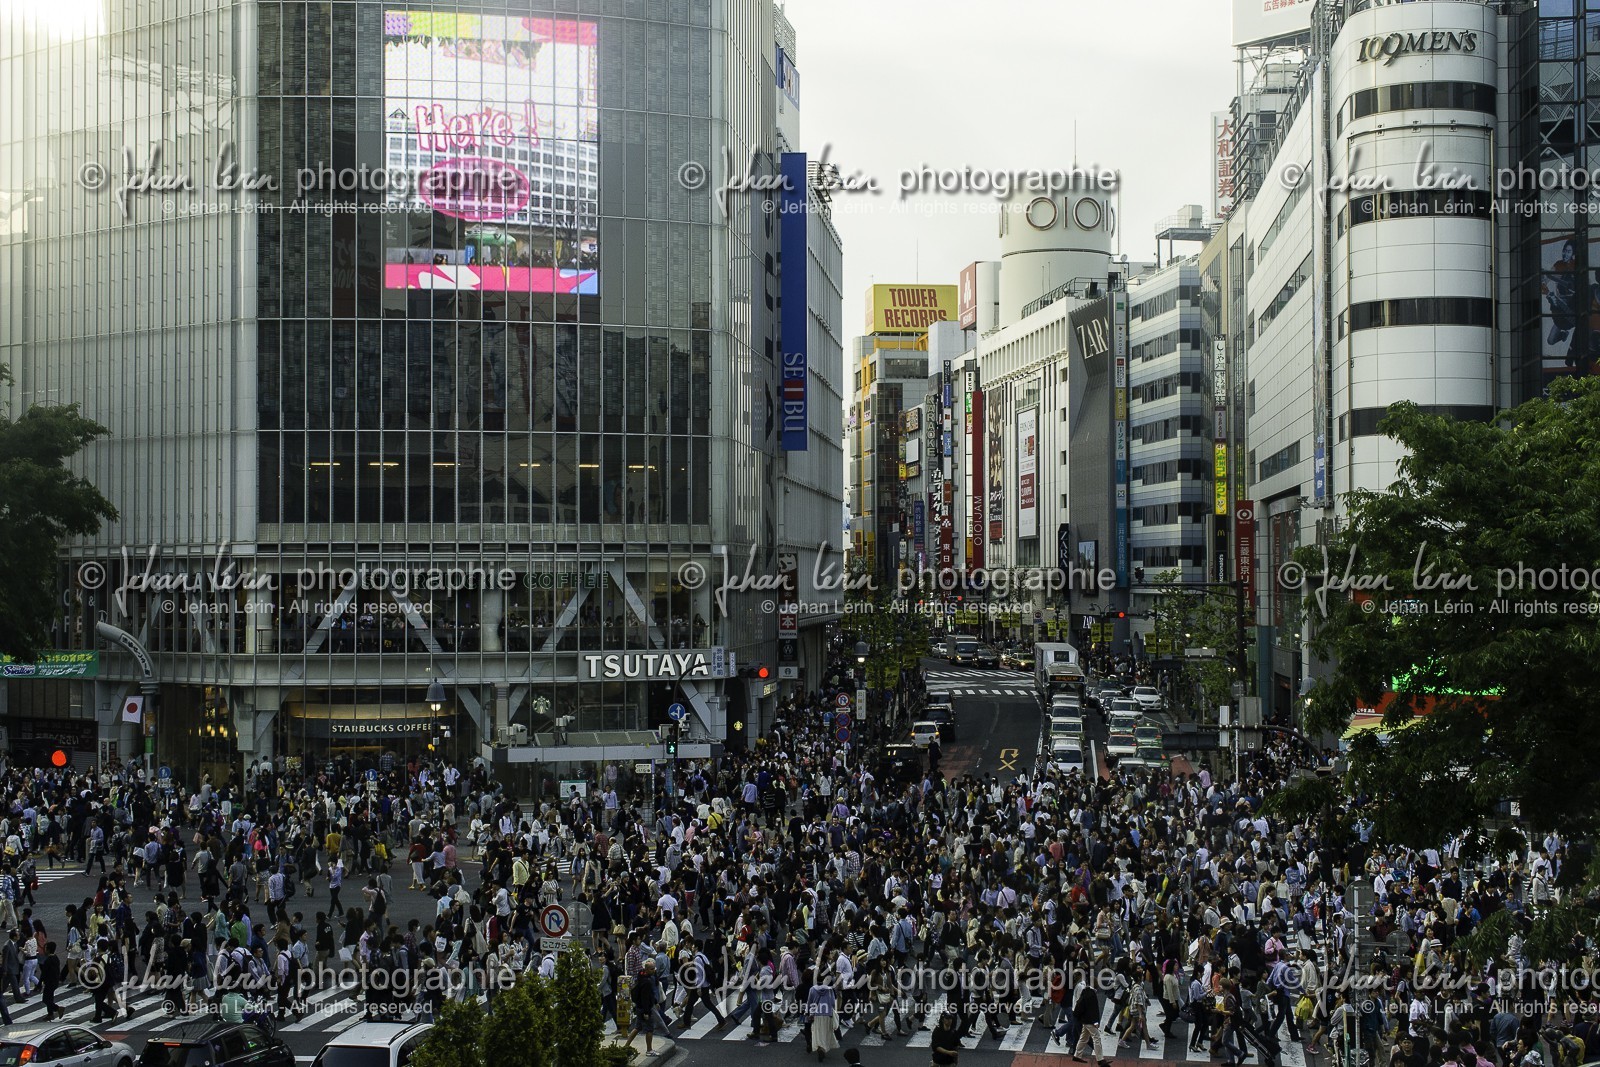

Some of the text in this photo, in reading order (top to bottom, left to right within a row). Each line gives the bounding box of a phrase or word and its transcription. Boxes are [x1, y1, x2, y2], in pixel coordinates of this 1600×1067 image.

[889, 288, 938, 308] TOWER
[784, 352, 804, 432] SEIBU
[523, 572, 609, 588] COFFEE
[585, 654, 708, 678] TSUTAYA
[332, 723, 431, 733] STARBUCKS COFFEE
[542, 940, 568, 950] ここから
